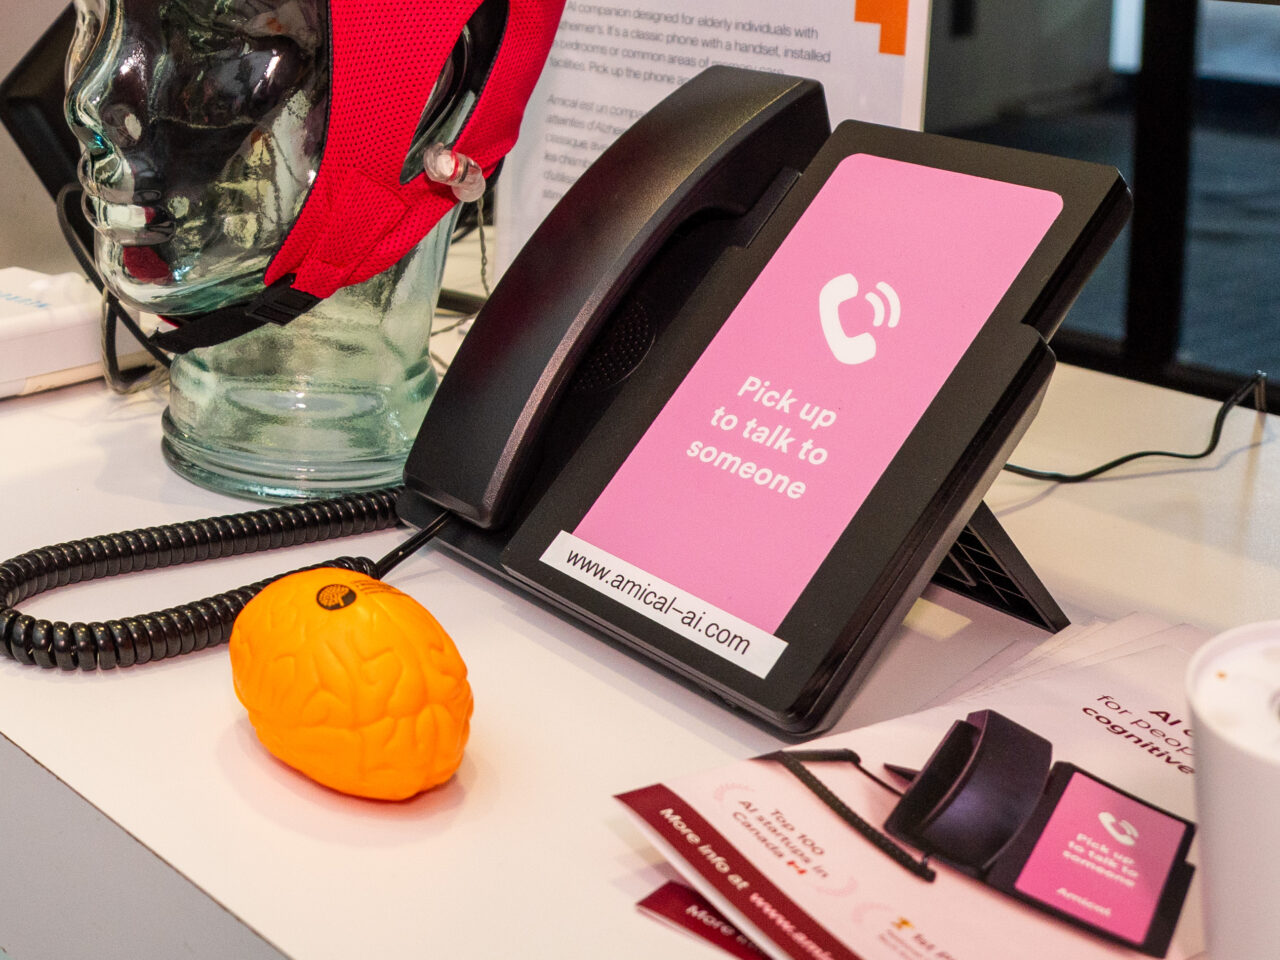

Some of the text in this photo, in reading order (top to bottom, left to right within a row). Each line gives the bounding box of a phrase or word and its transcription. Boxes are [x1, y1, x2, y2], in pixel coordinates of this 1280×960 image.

[578, 3, 632, 18] companion
[633, 8, 679, 24] designed
[681, 13, 695, 25] for
[698, 16, 732, 32] elderly
[734, 19, 792, 37] individuals
[794, 26, 819, 40] with
[621, 48, 666, 62] common
[667, 54, 697, 67] areas
[698, 56, 709, 69] of
[630, 28, 663, 42] classic
[666, 33, 699, 48] phone
[701, 37, 723, 50] with
[724, 41, 732, 51] a
[783, 46, 831, 63] installed
[588, 60, 609, 75] Pick
[611, 66, 623, 78] up
[626, 67, 641, 80] the
[643, 70, 675, 85] phone
[737, 376, 838, 430] Pick up
[711, 406, 828, 465] to talk to
[686, 440, 806, 499] someone
[566, 550, 751, 655] www.amical-ai.com
[1082, 707, 1195, 774] cognitive
[1097, 695, 1193, 756] for peop
[1148, 709, 1182, 726] AI
[659, 808, 701, 845] More
[698, 844, 730, 873] info
[727, 874, 750, 891] at
[732, 811, 784, 858] Canada
[739, 801, 829, 878] AI startups in
[771, 808, 825, 855] Top 100
[1076, 833, 1135, 866] Pick up
[1062, 850, 1135, 887] someone
[1068, 841, 1139, 878] to talk to
[685, 904, 735, 936] More
